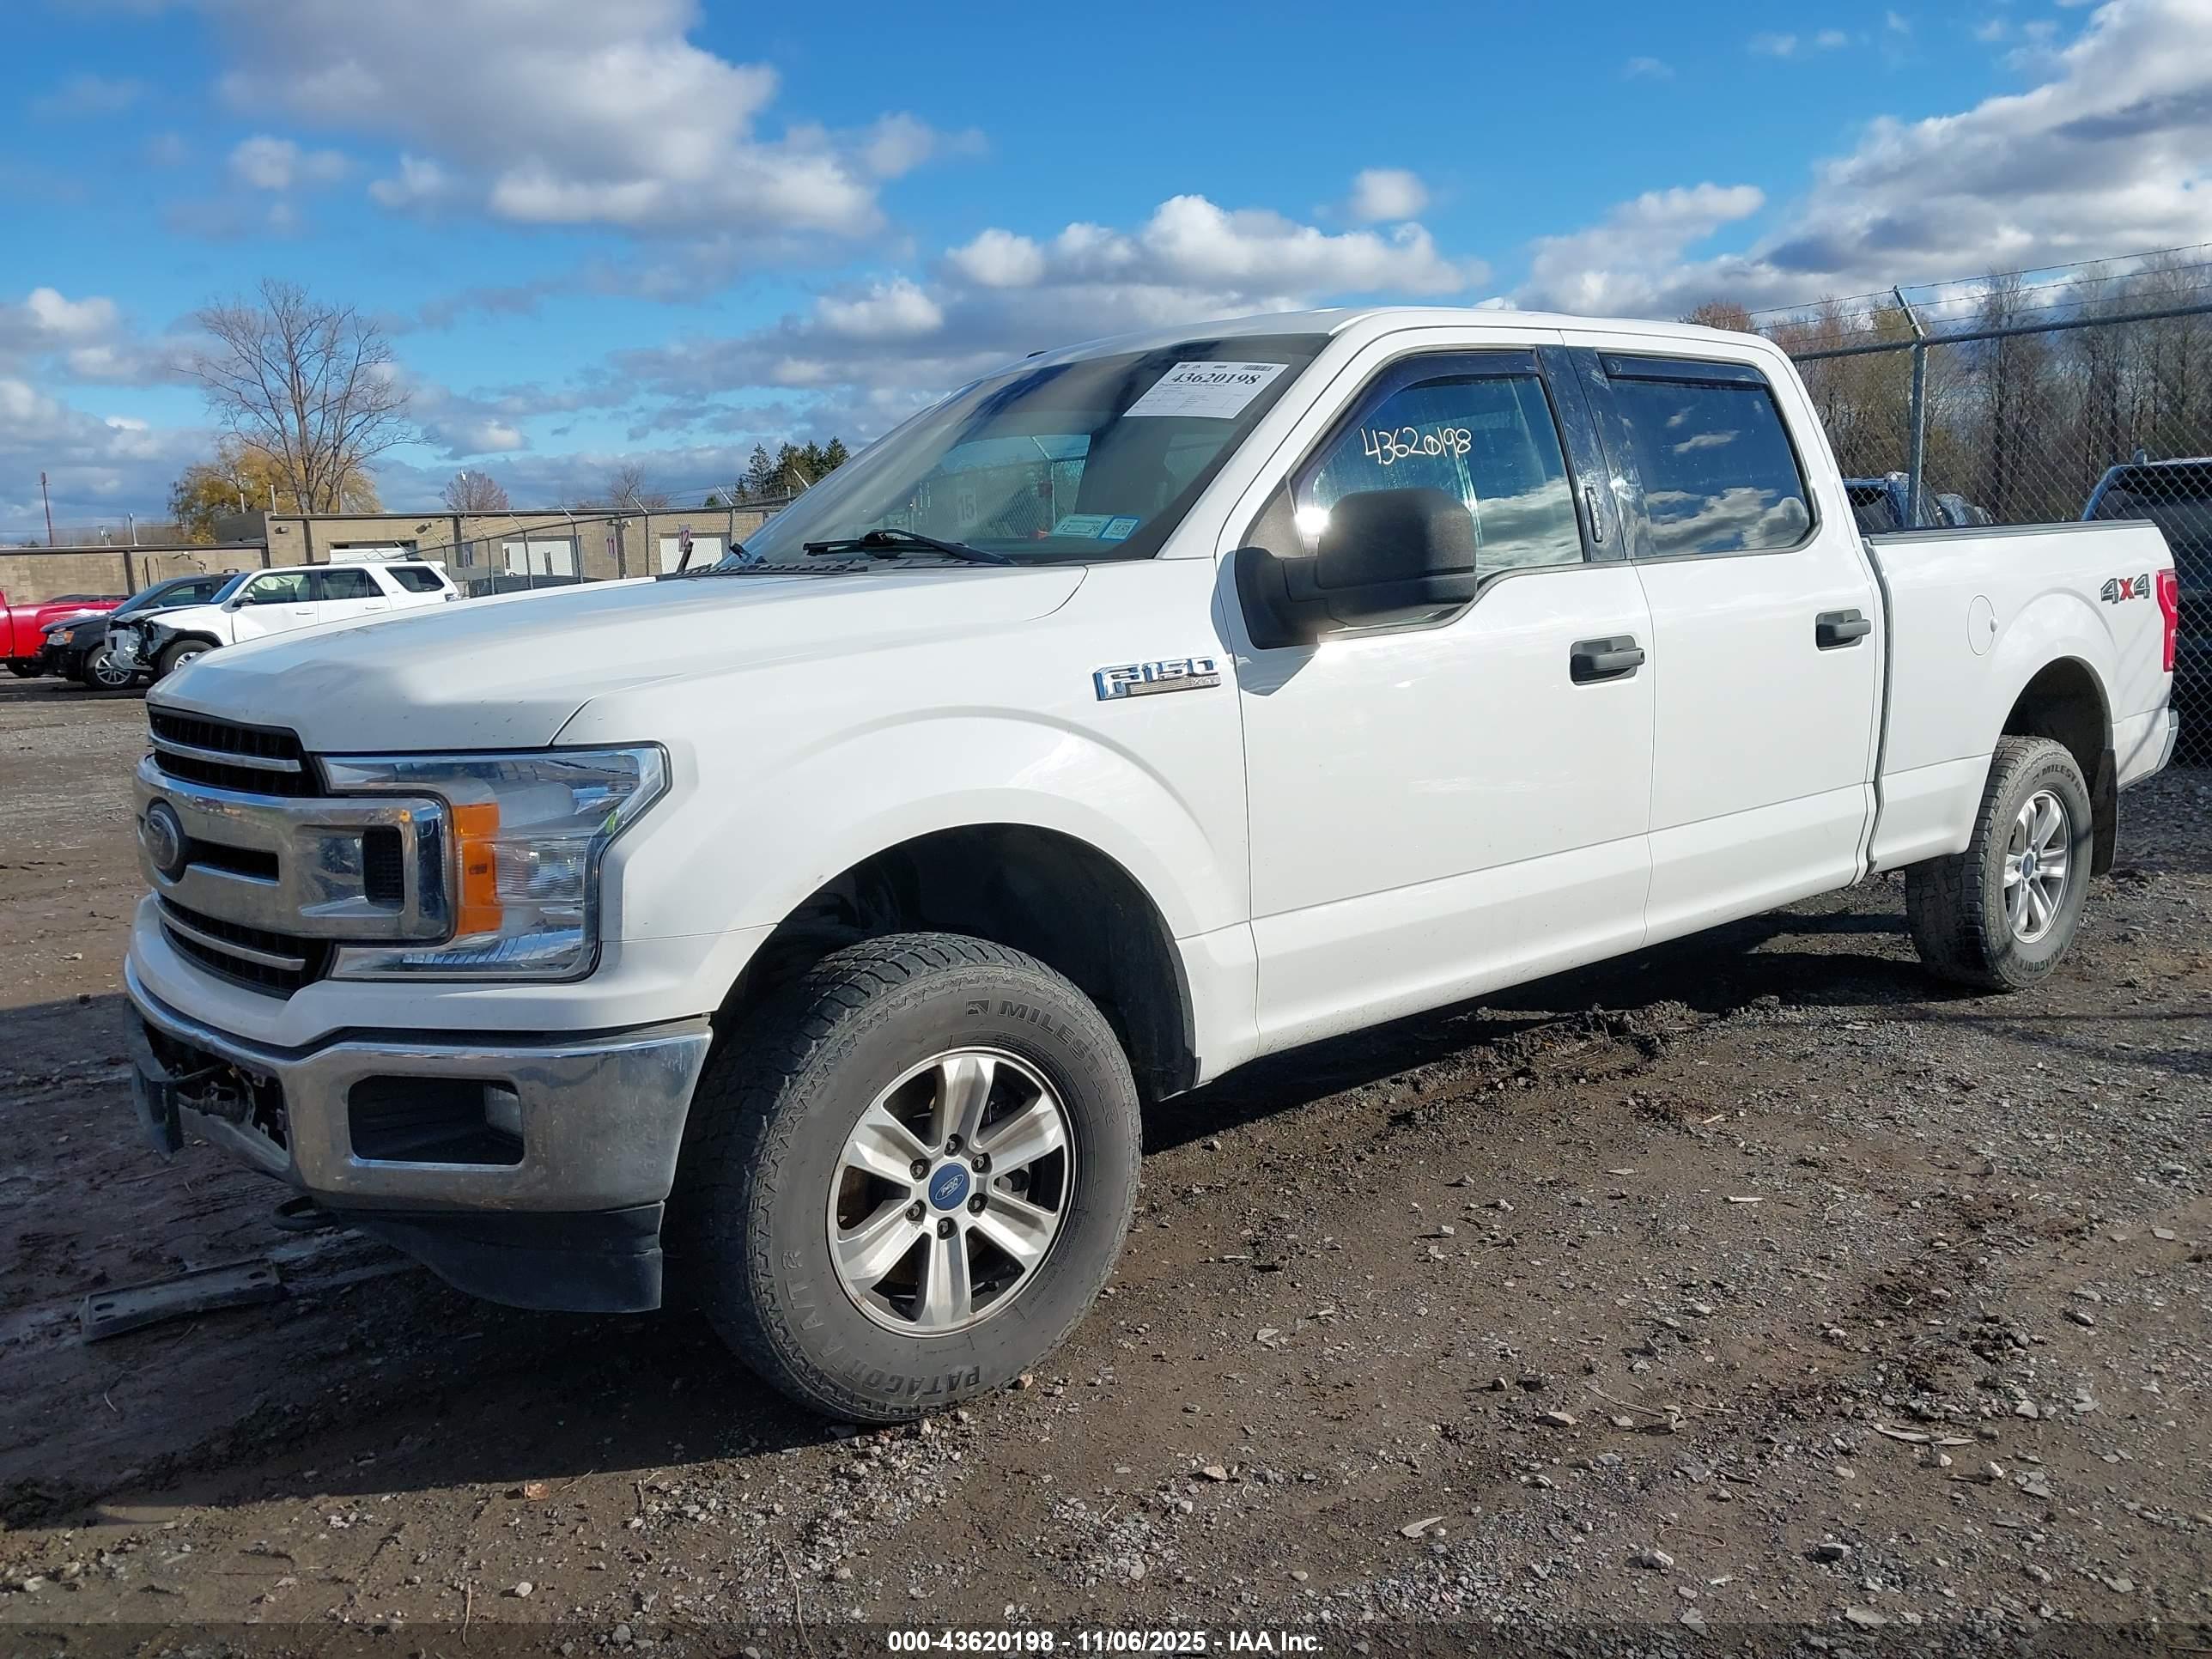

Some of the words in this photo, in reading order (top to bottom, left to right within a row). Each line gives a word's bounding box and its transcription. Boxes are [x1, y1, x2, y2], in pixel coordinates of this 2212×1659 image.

[1171, 372, 1261, 385] 43620198
[1359, 426, 1472, 465] 43620198
[998, 1000, 1121, 1127] MILESTAR
